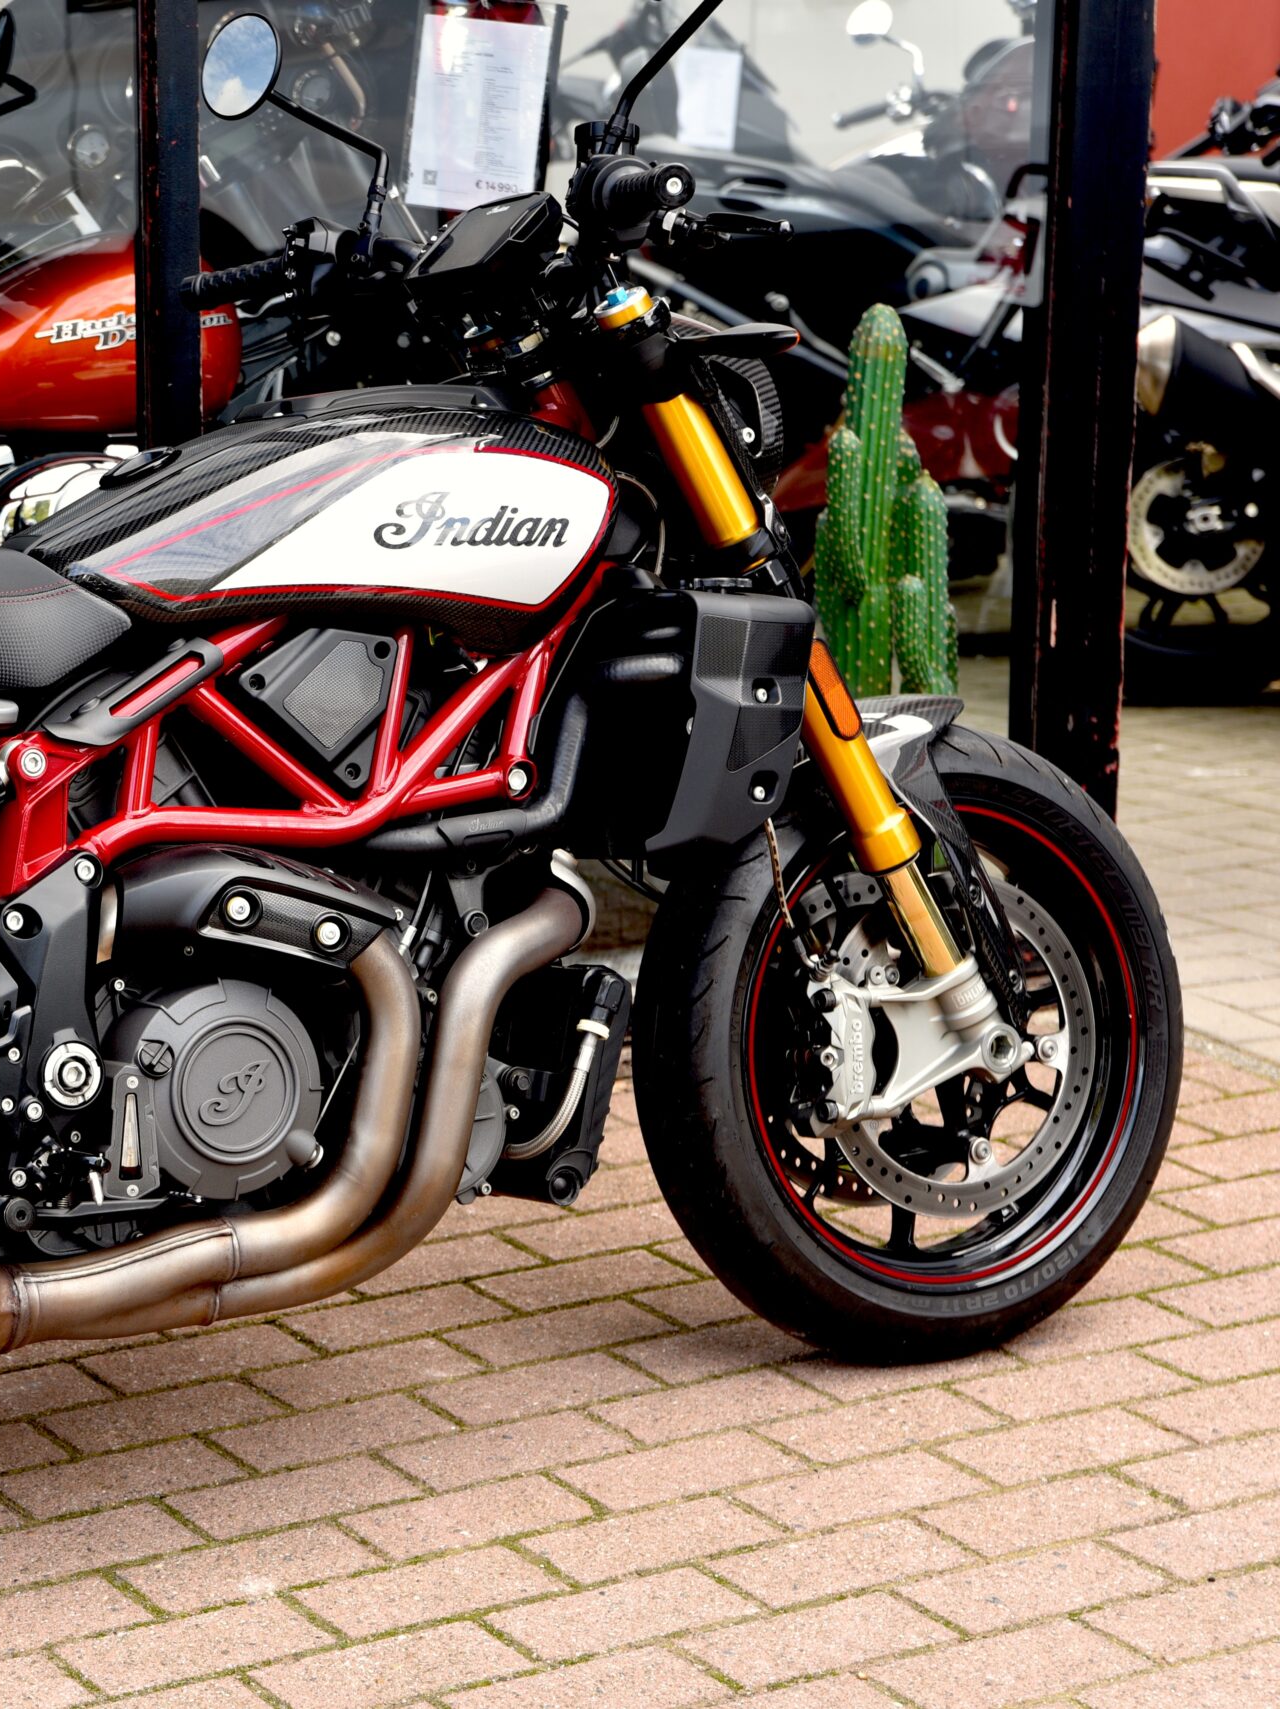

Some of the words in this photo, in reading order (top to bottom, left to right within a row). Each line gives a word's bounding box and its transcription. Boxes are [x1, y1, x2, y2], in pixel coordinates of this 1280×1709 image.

[48, 310, 136, 343] Harle
[373, 491, 570, 550] Indian
[848, 1018, 866, 1095] brembo
[1002, 1240, 1080, 1303] 120/70
